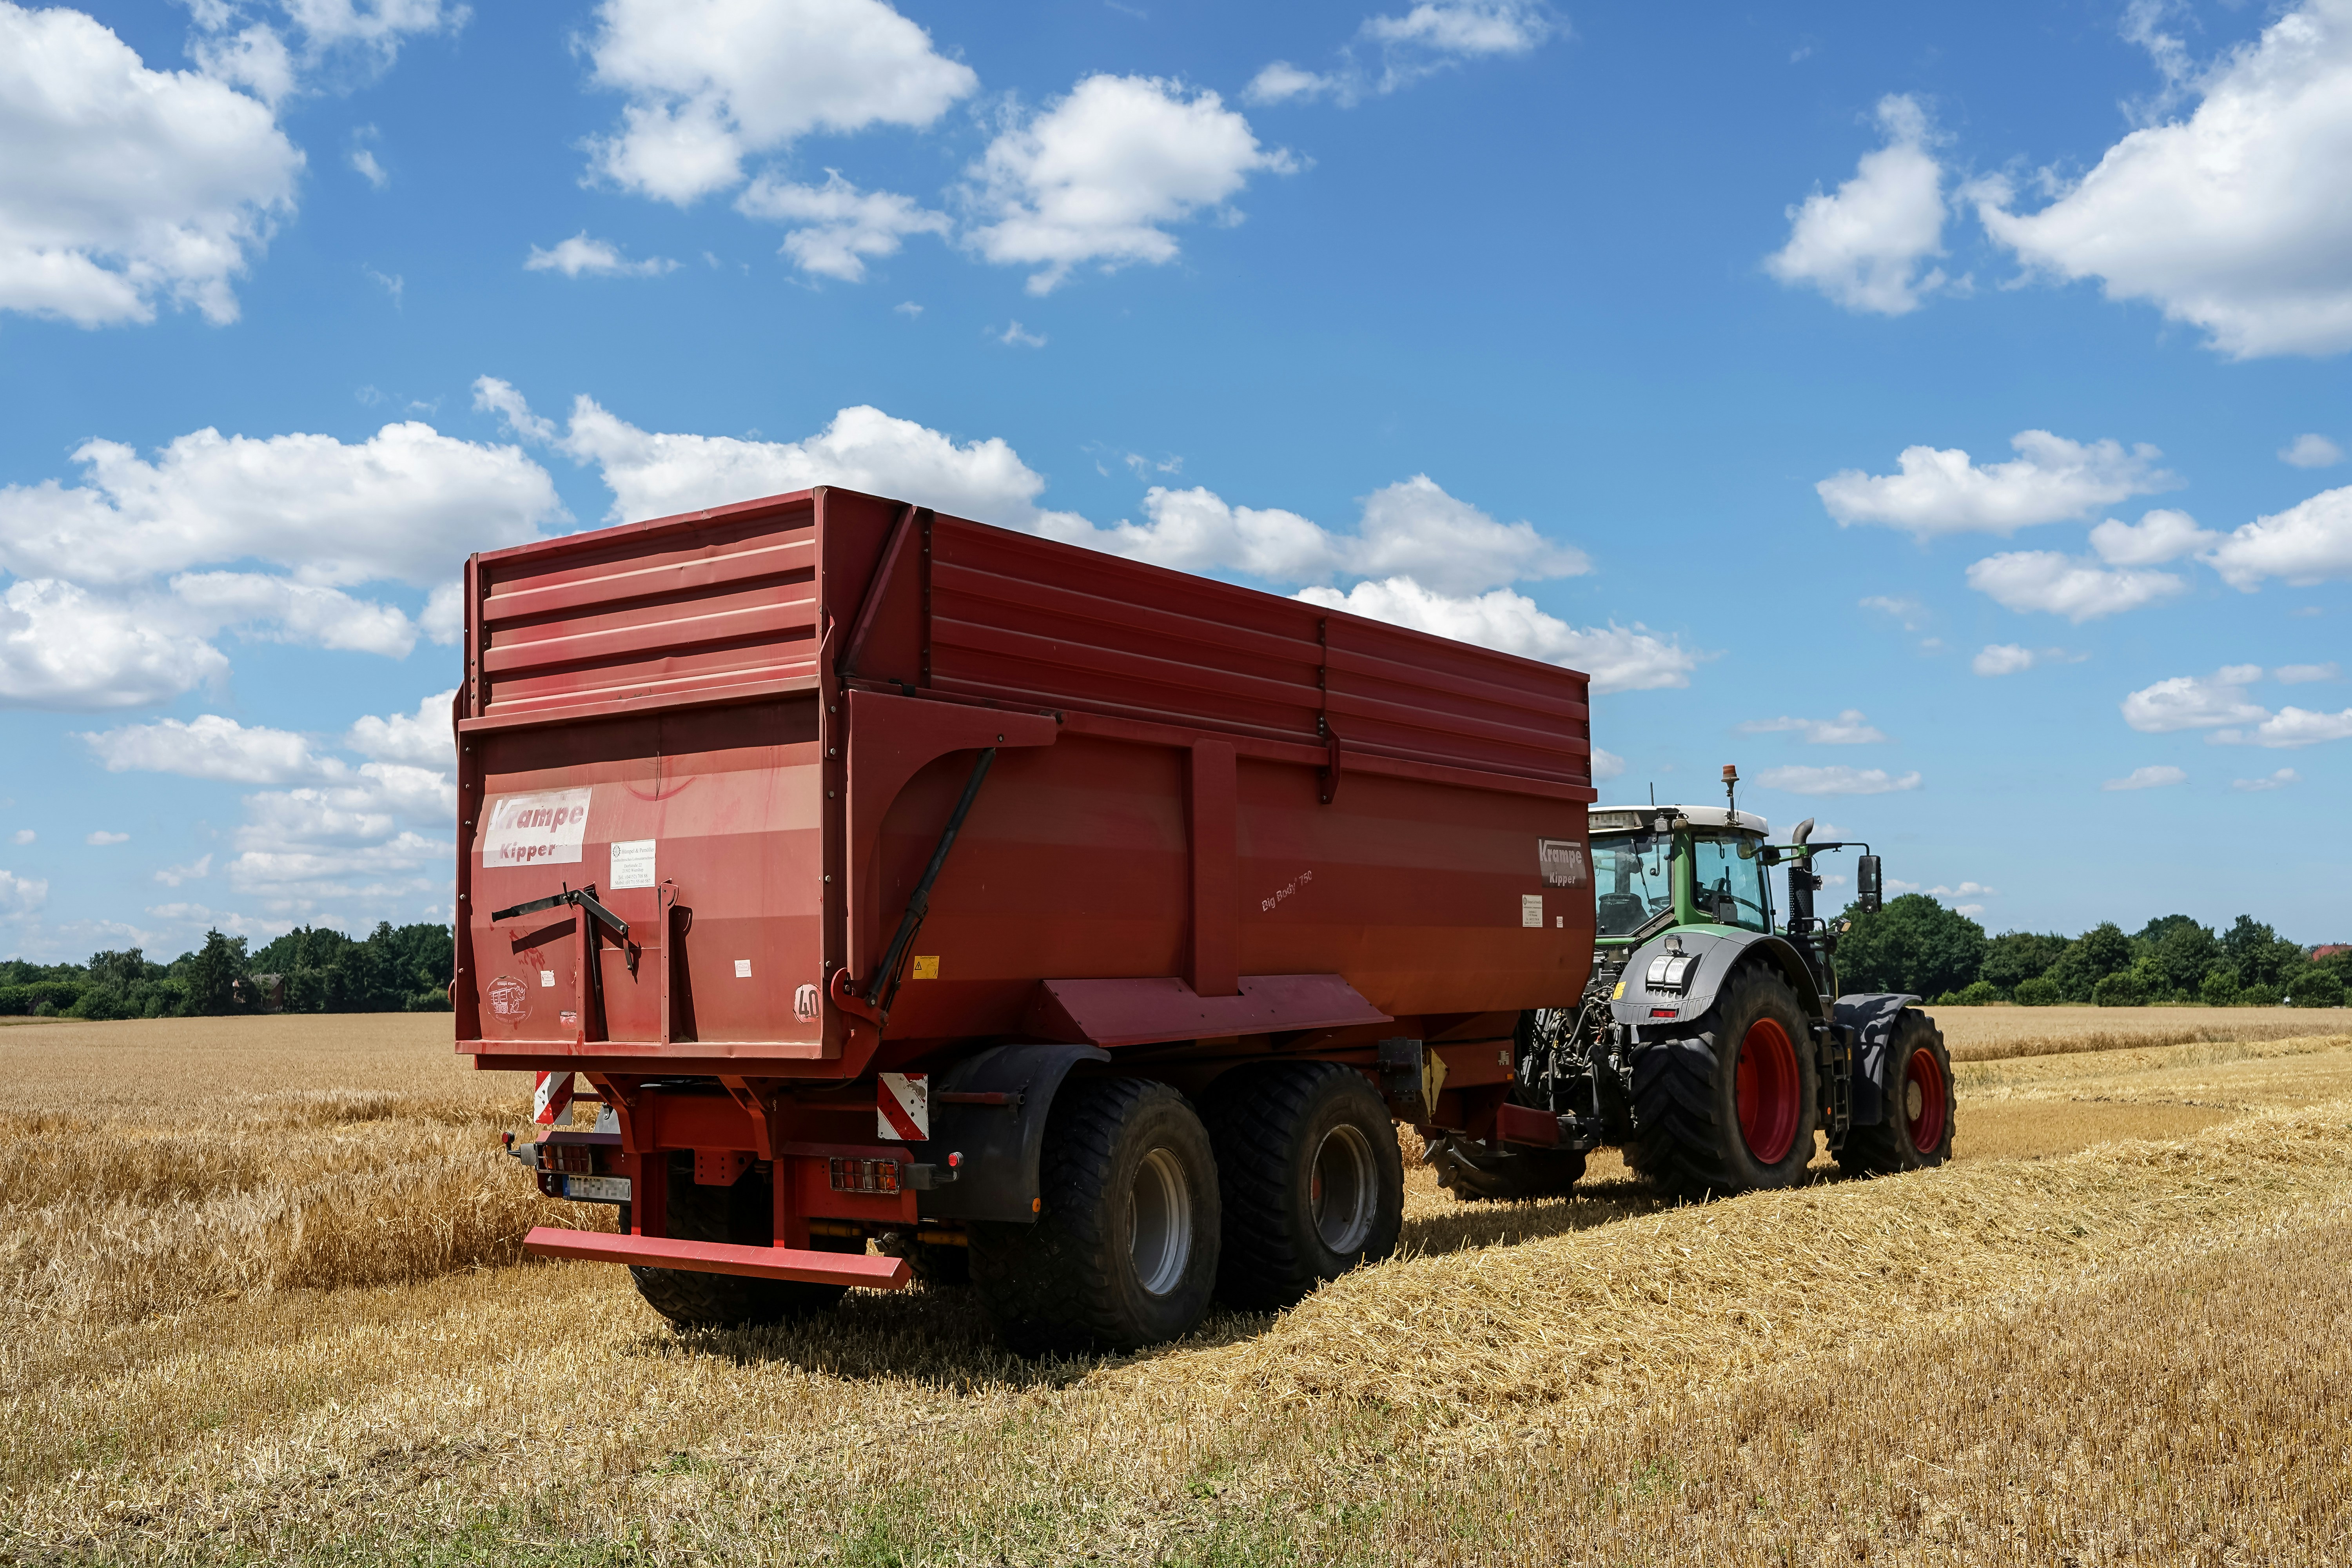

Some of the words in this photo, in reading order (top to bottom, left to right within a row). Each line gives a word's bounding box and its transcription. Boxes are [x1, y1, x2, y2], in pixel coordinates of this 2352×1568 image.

[489, 798, 584, 833] Krampe
[499, 842, 556, 862] Kipper
[1538, 839, 1582, 869] Krampe
[1262, 897, 1276, 911] Big
[1299, 870, 1312, 886] 750
[1550, 871, 1576, 886] Kipper
[799, 990, 819, 1018] 40
